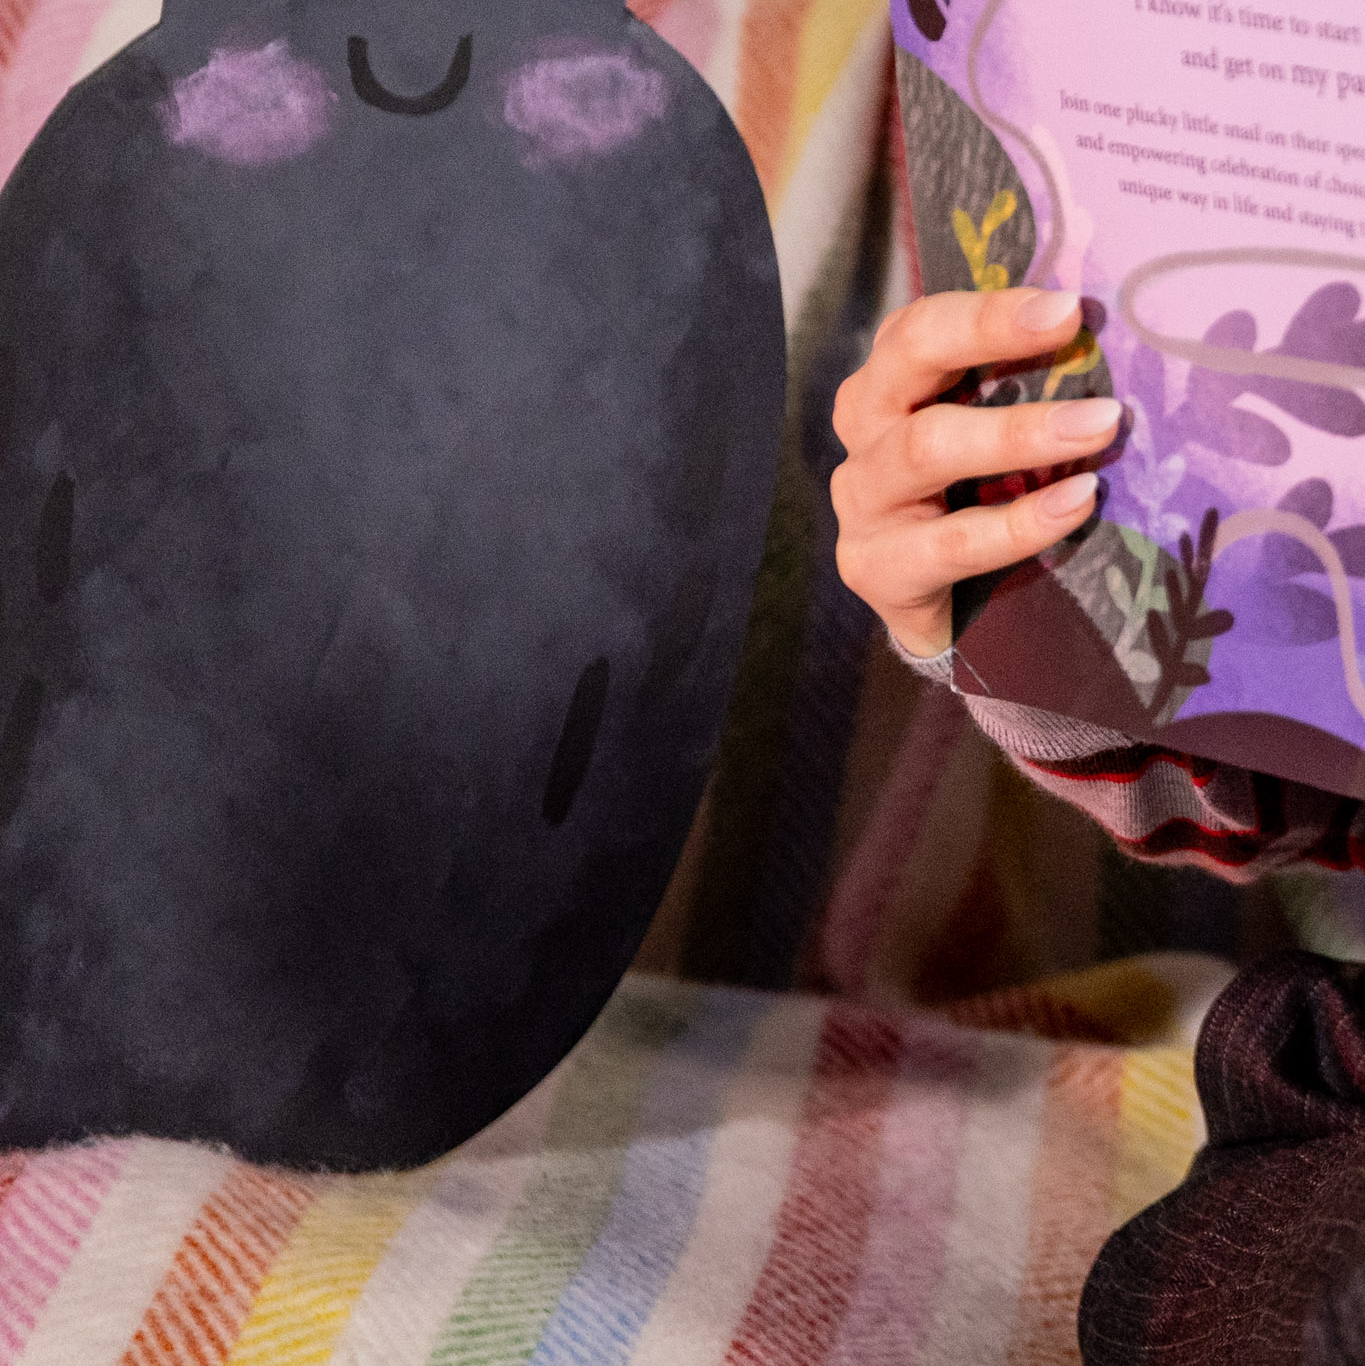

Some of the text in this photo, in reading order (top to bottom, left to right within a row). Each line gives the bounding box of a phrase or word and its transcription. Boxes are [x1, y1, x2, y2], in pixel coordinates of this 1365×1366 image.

[1238, 6, 1285, 31] time
[1289, 16, 1311, 36] to
[1315, 21, 1361, 45] start
[1180, 46, 1219, 72] and
[1223, 56, 1253, 80] get
[1257, 61, 1286, 81] on
[1290, 64, 1328, 97] my
[1059, 89, 1090, 112] Join
[1093, 100, 1122, 119] one
[1125, 103, 1178, 133] plucky
[1181, 109, 1219, 135] little
[1264, 130, 1288, 147] on
[1290, 132, 1330, 154] their
[1075, 132, 1105, 152] and
[1107, 140, 1208, 176] empowering
[1209, 156, 1300, 186] celebration
[1303, 170, 1322, 189] of
[1118, 179, 1173, 203] unique
[1176, 188, 1208, 213] way
[1212, 196, 1230, 211] in
[1233, 192, 1258, 216] life
[1262, 202, 1293, 223] and
[1297, 210, 1356, 240] staying
